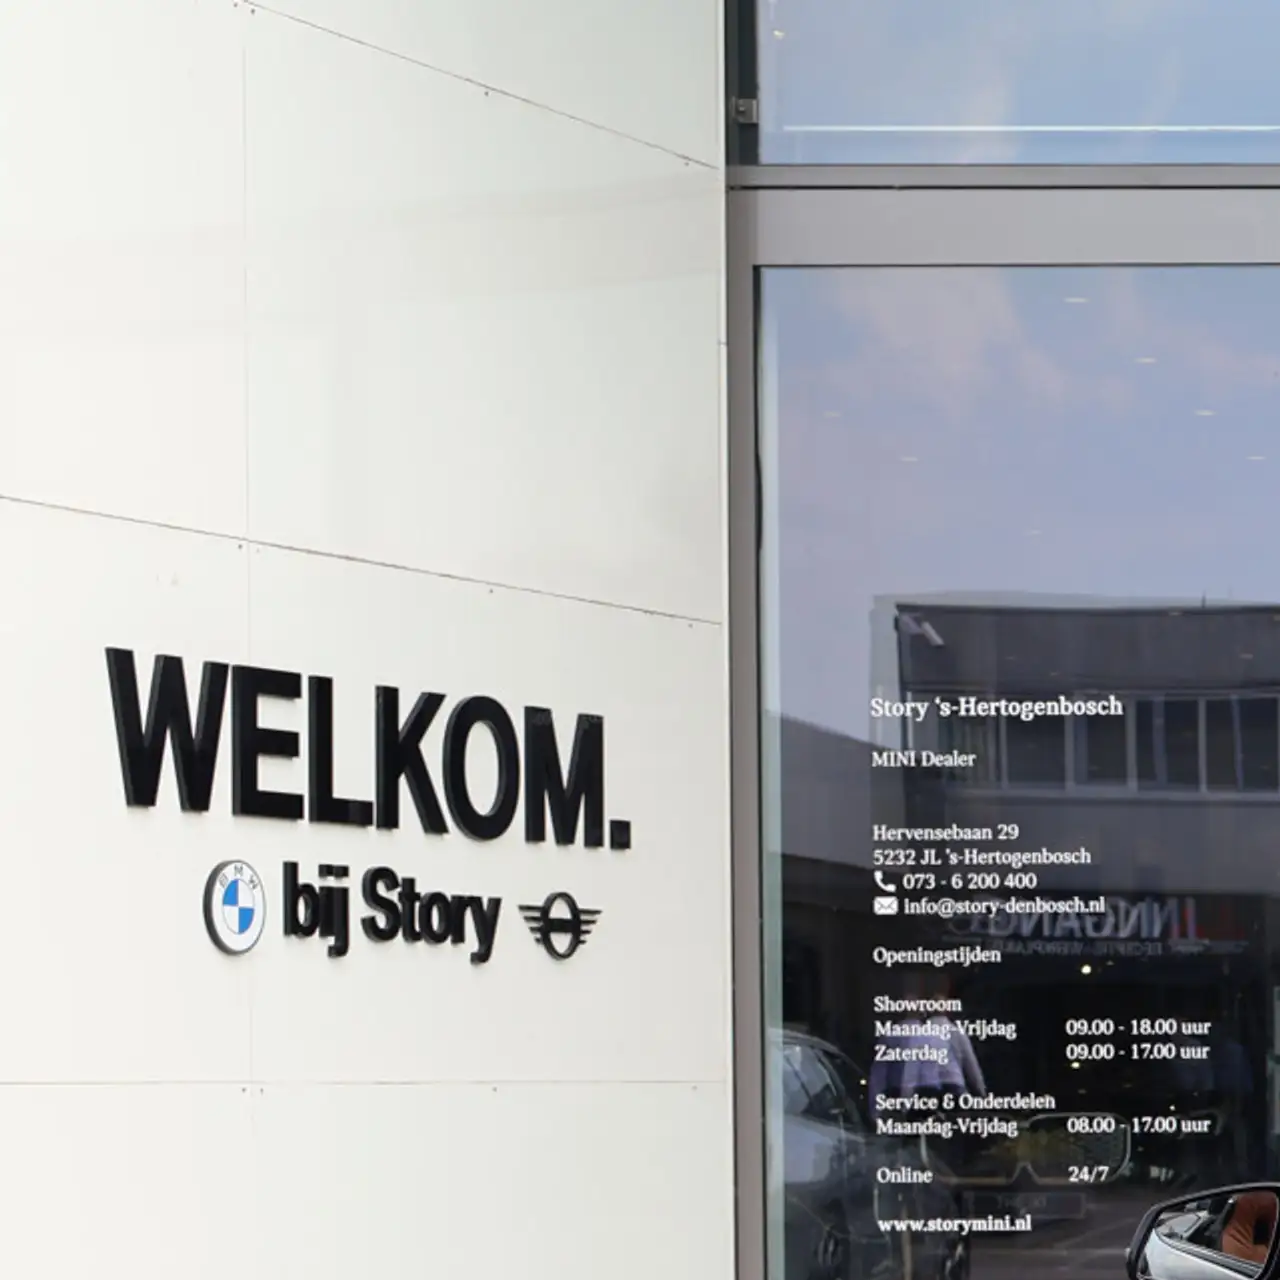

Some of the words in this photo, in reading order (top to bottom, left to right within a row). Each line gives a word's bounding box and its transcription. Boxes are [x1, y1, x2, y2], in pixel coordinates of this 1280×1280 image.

[870, 696, 928, 721] Story
[105, 647, 631, 850] WELKOM.
[871, 751, 915, 767] MINI
[921, 750, 976, 767] Dealer
[872, 823, 992, 841] Hervensebaan
[997, 824, 1020, 840] 29
[873, 849, 916, 865] 5232
[920, 849, 942, 865] JL
[903, 873, 936, 889] 073
[951, 873, 963, 889] 6
[968, 873, 1000, 889] 200
[1004, 873, 1037, 889] 400
[282, 861, 350, 957] bij
[361, 865, 502, 965] Story
[903, 896, 1106, 918] info@story-denbosch.nl
[873, 947, 1001, 969] Openingstijden
[873, 996, 962, 1013] Showroom
[875, 1019, 1017, 1041] Maandag-Vrijdag
[1065, 1018, 1115, 1035] 09.00
[1130, 1018, 1177, 1035] 18.00
[1181, 1021, 1212, 1035] uur
[875, 1044, 948, 1065] Zaterdag
[1065, 1043, 1115, 1060] 09.00
[1131, 1043, 1176, 1059] 17.00
[1180, 1046, 1210, 1059] uur
[875, 1094, 938, 1110] Service
[943, 1094, 954, 1110] &
[959, 1092, 1056, 1110] Onderdelen
[876, 1117, 1019, 1138] Maandag-Vrijdag
[1067, 1117, 1115, 1133] 08.00
[1132, 1116, 1177, 1133] 17.00
[1181, 1119, 1211, 1133] uur
[876, 1168, 932, 1183] Online
[1067, 1166, 1109, 1183] 24/7
[878, 1215, 1032, 1235] www.storymini.nl
